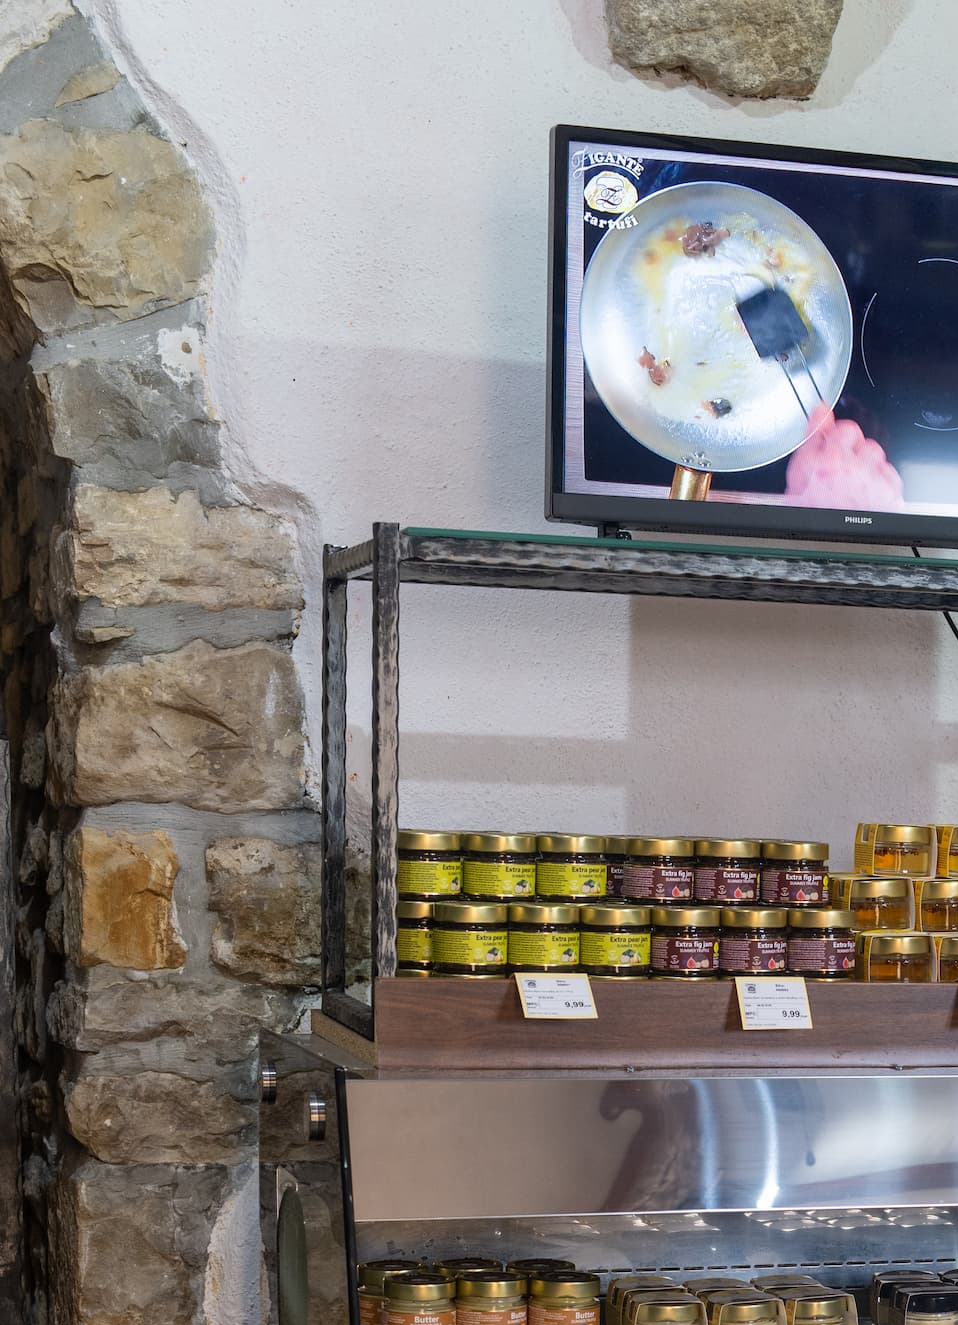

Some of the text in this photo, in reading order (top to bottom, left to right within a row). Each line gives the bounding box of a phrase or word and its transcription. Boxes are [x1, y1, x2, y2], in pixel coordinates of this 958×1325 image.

[584, 211, 639, 230] tartufi
[844, 515, 873, 524] PHILIPS
[678, 870, 686, 879] fig
[740, 871, 748, 880] fig
[803, 874, 812, 882] fig
[693, 941, 702, 949] fig
[758, 941, 773, 949] Extra
[564, 1001, 584, 1009] 9,99
[782, 1010, 801, 1018] 9,99
[414, 1315, 439, 1324] Butter
[575, 1311, 595, 1320] Butter
